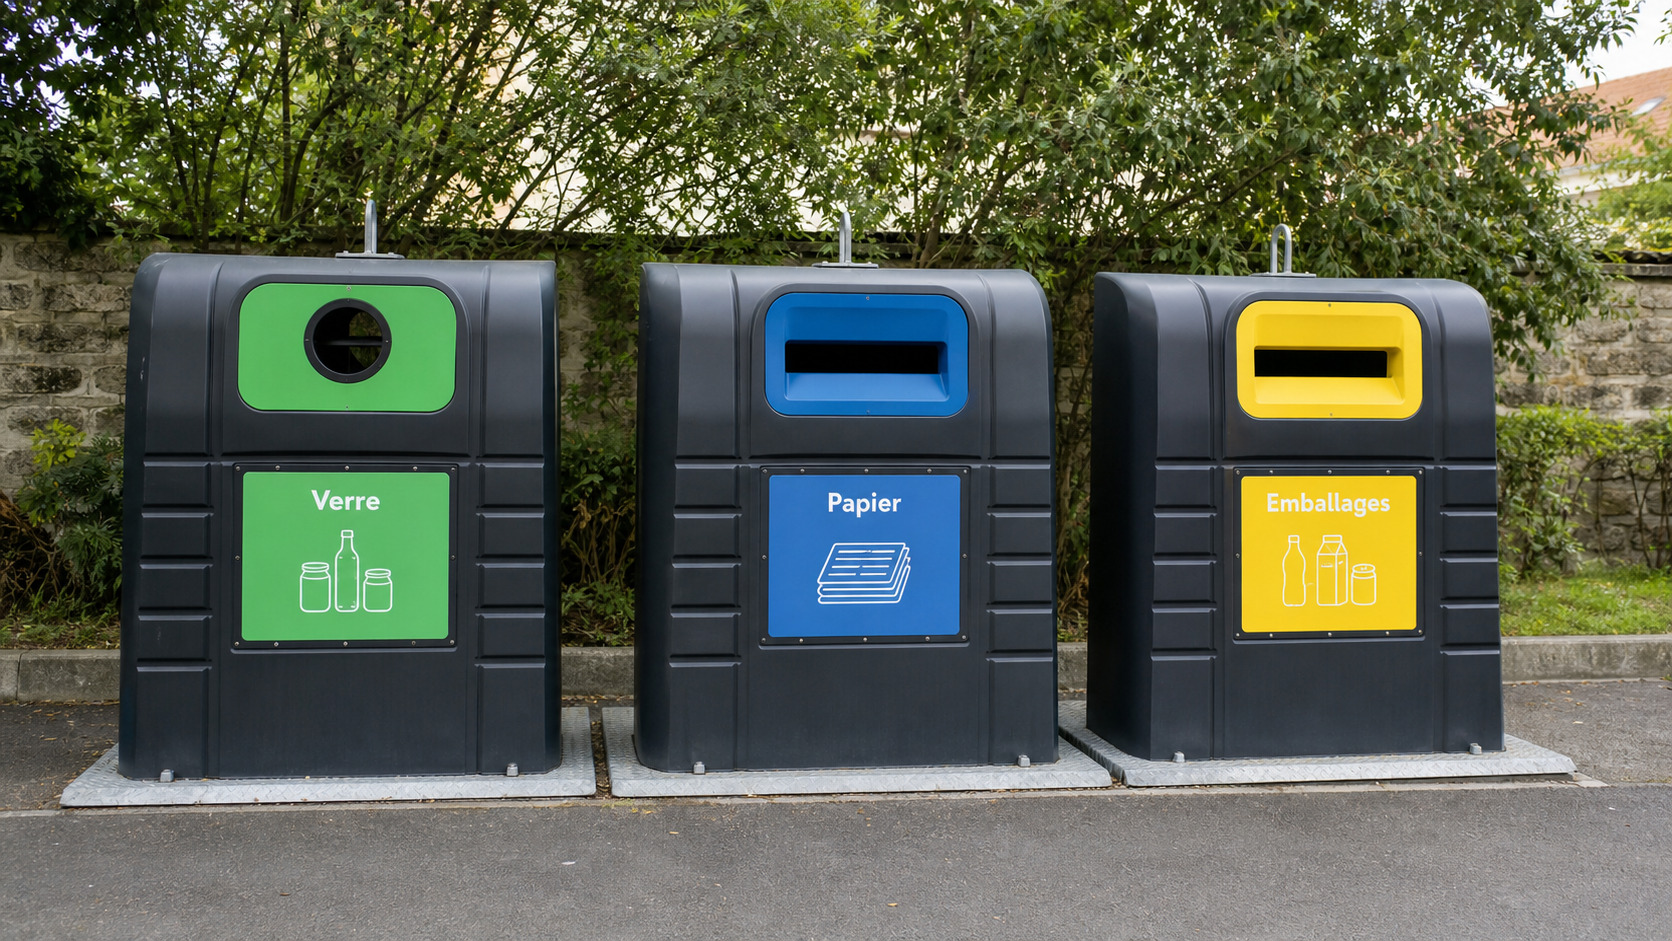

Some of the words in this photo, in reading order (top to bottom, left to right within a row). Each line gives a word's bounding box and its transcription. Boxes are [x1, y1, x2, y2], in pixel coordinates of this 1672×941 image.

[311, 490, 380, 511] Verre
[828, 491, 902, 518] Papier
[1267, 492, 1391, 518] Emballages
